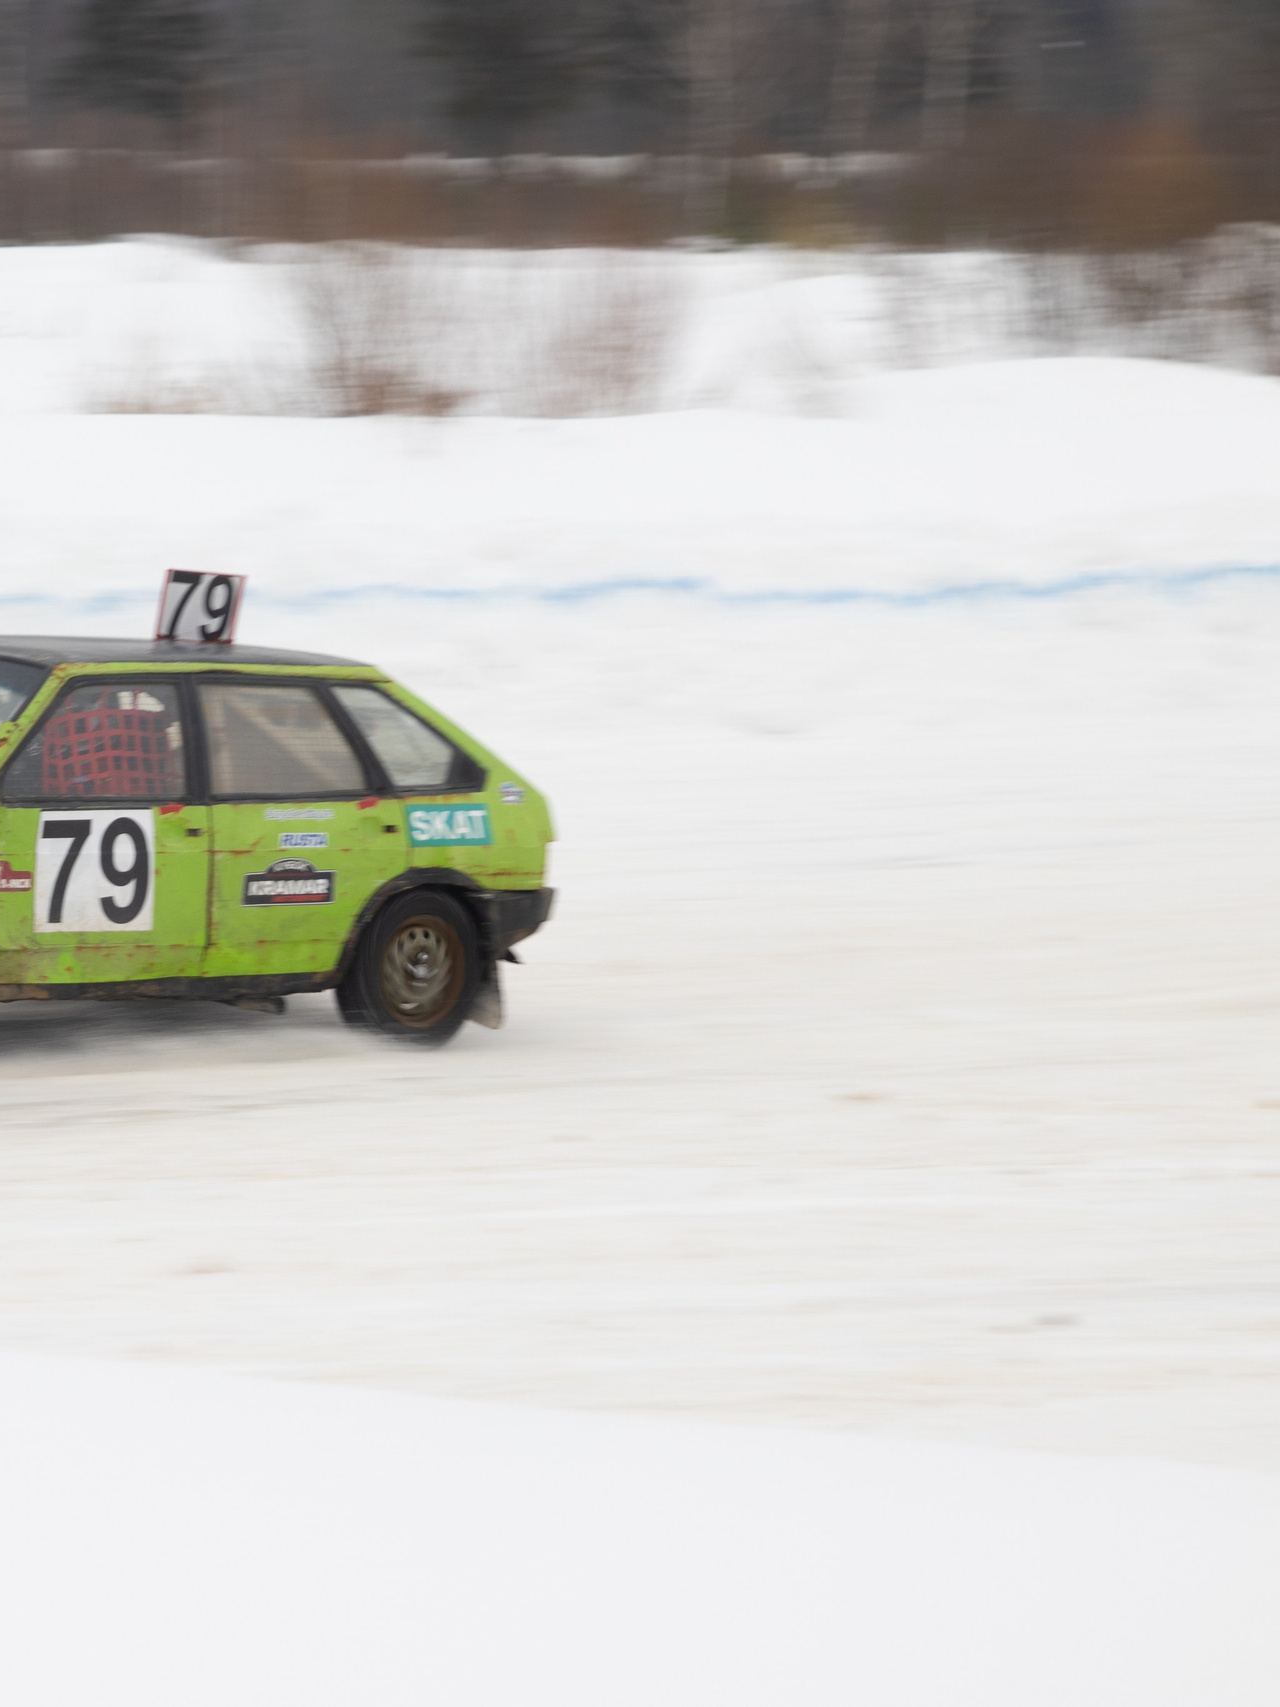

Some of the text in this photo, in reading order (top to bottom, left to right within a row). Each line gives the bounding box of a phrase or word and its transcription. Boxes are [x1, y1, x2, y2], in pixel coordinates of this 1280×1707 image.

[167, 570, 232, 641] 79
[409, 810, 488, 841] SKAT
[42, 816, 149, 924] 79
